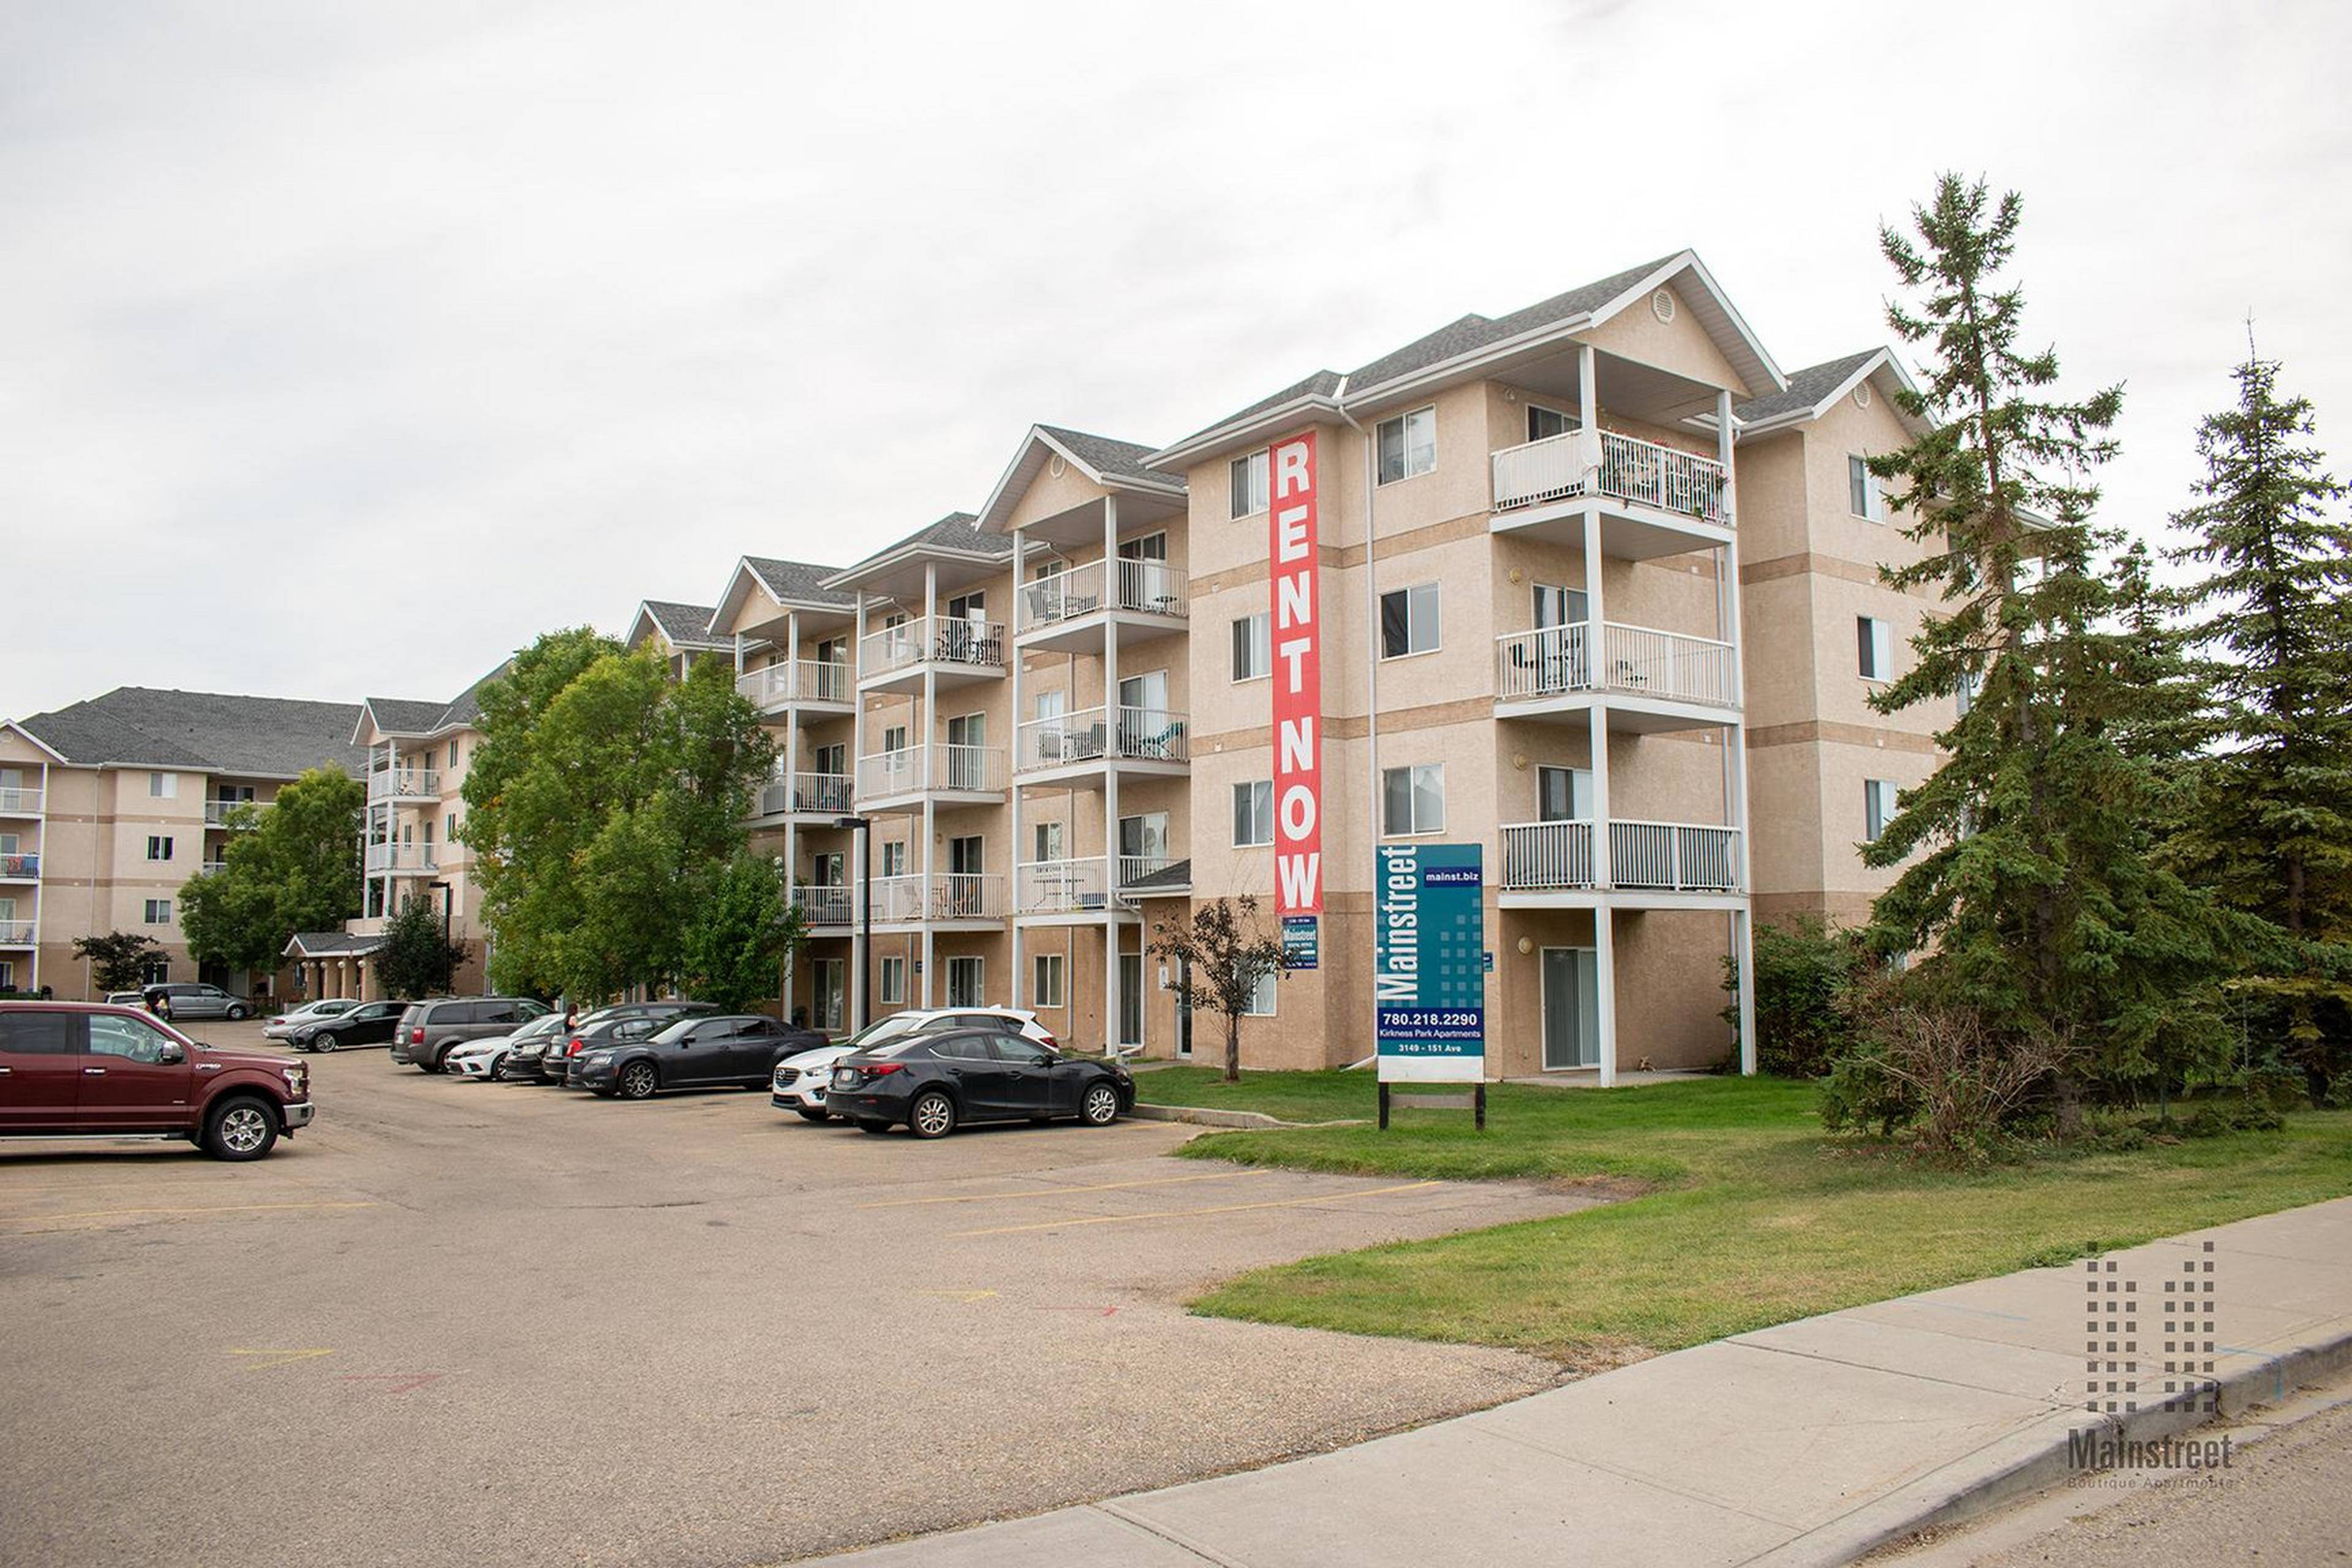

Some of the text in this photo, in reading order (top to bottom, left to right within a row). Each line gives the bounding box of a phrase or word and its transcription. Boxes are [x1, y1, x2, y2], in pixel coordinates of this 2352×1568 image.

[1277, 440, 1311, 693] RENT
[1278, 716, 1320, 909] NOW
[1426, 872, 1479, 881] mainst.biz
[1378, 846, 1418, 1000] Mainstreet
[1383, 1013, 1477, 1026] 780.218.2290
[1433, 1030, 1481, 1038] Apartments
[1398, 1044, 1419, 1052] 3149
